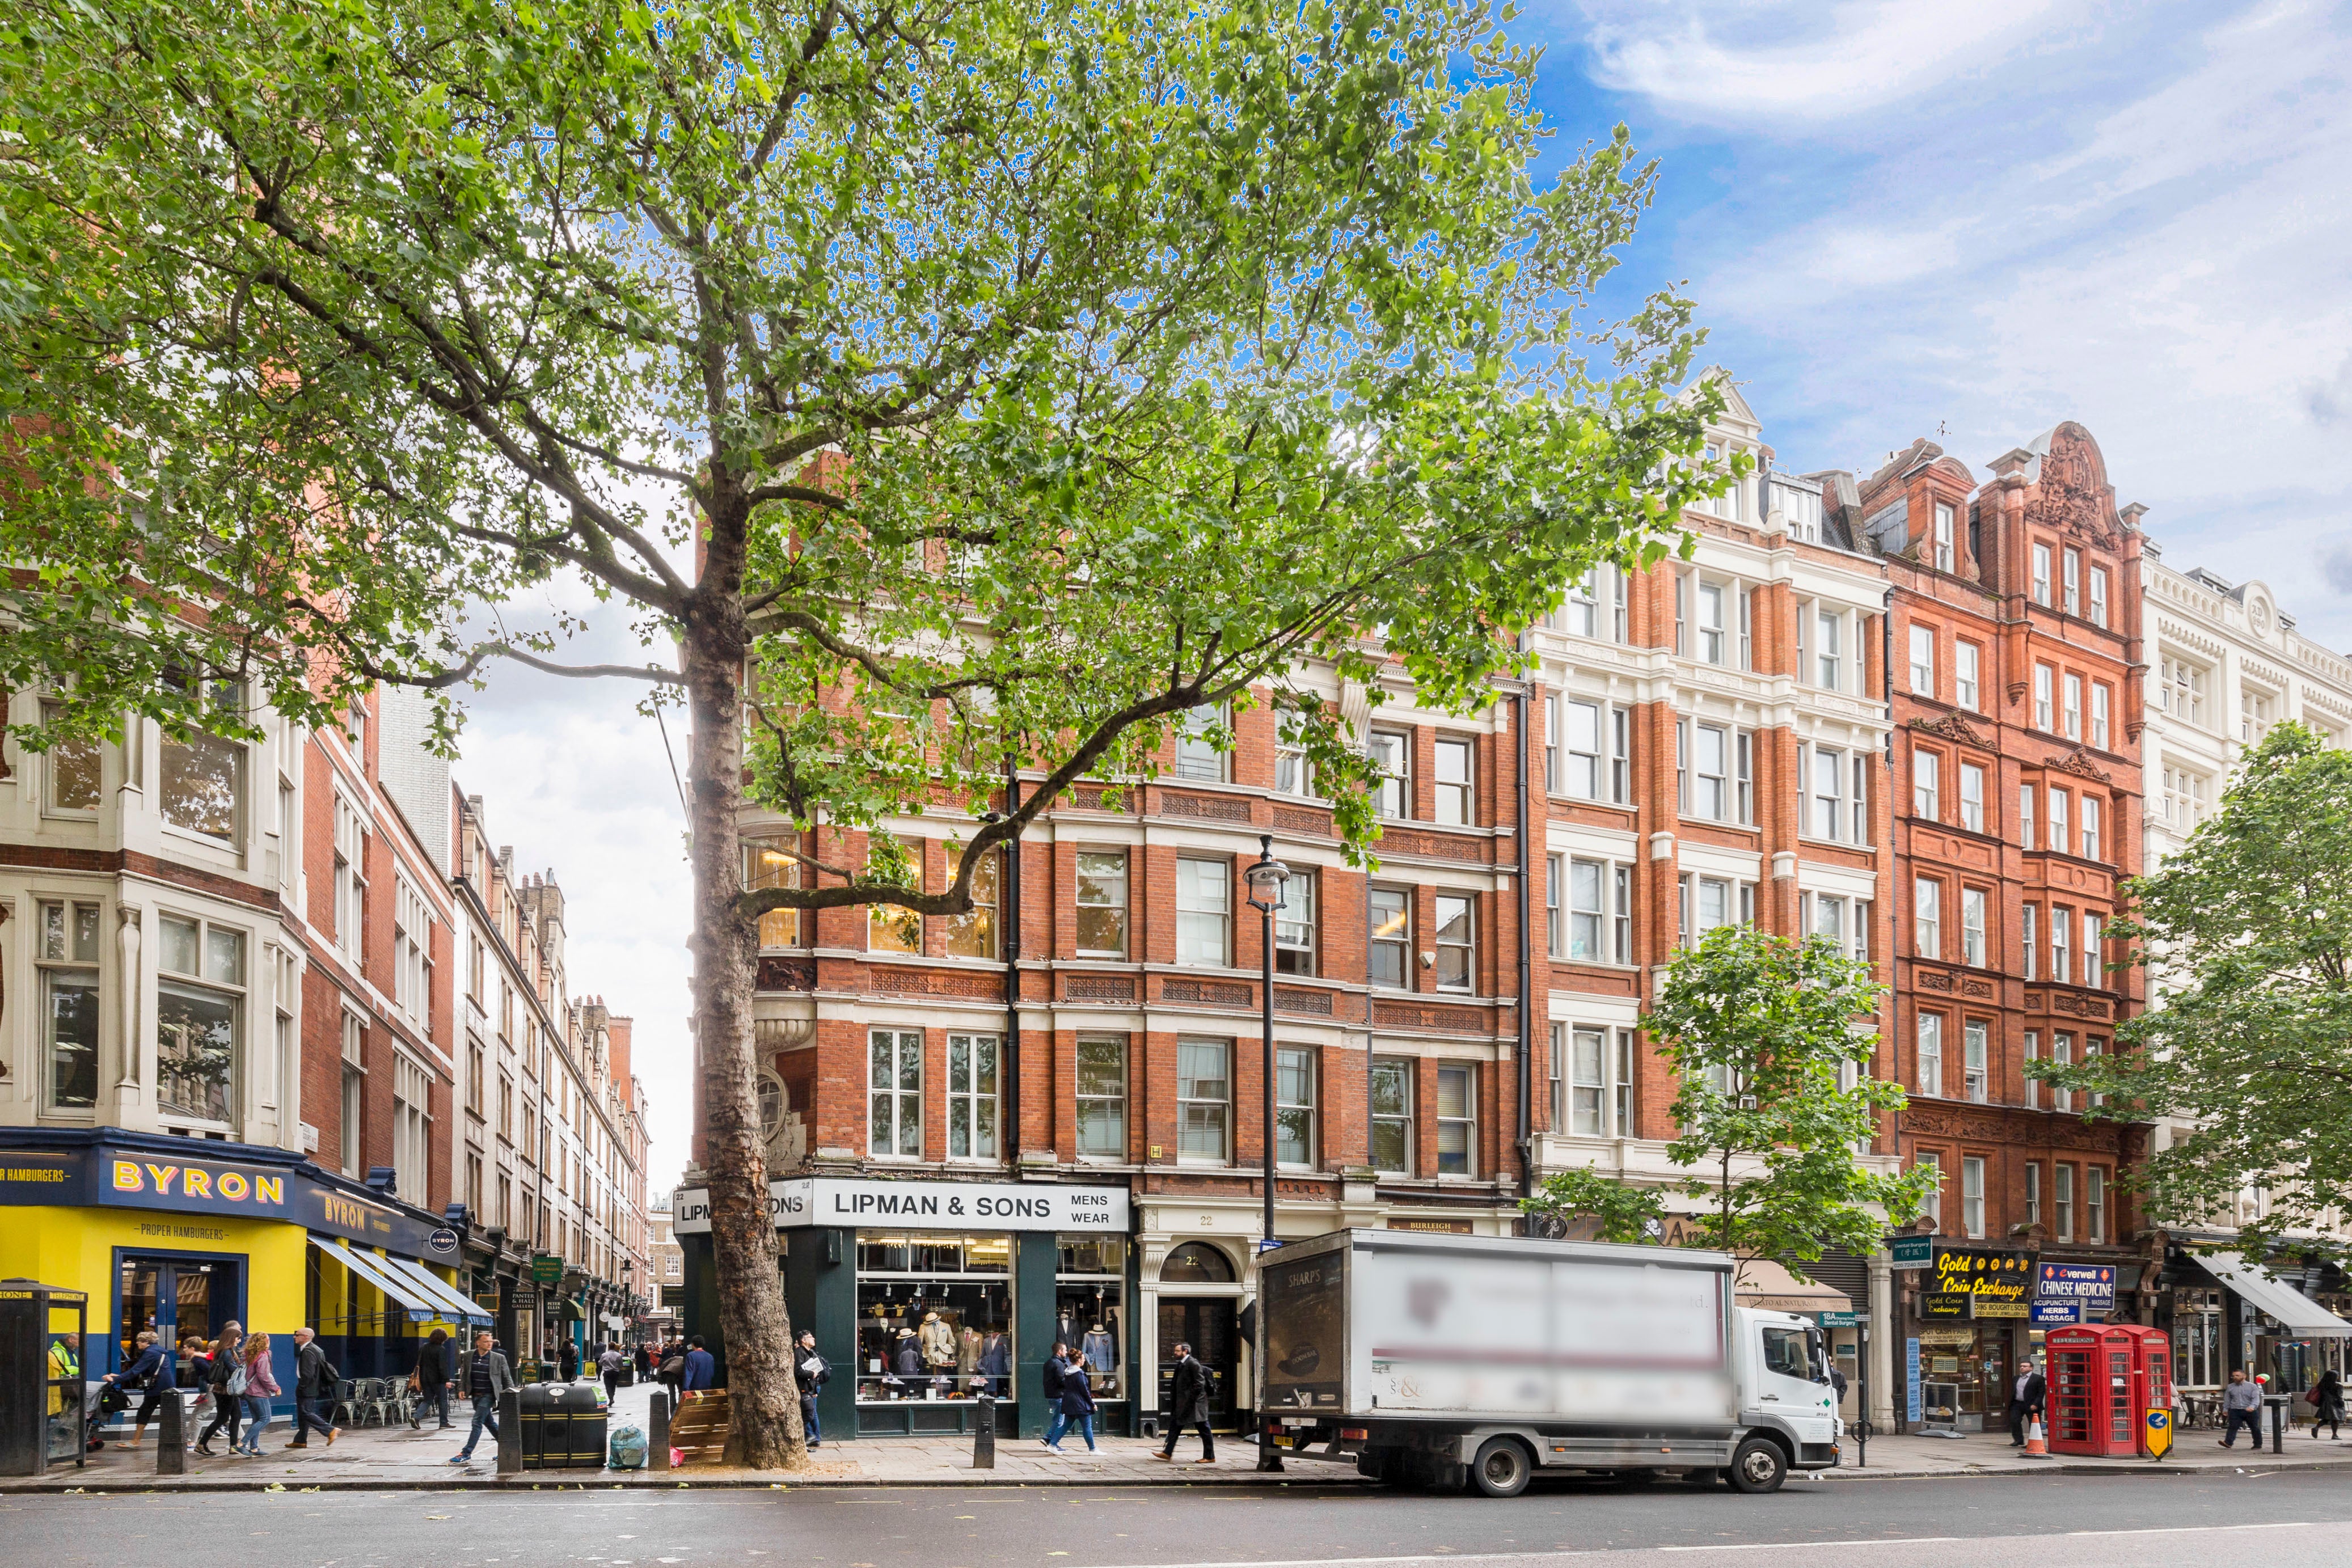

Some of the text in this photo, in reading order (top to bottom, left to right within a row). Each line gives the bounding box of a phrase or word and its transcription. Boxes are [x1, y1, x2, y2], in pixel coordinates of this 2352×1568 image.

[7, 1168, 64, 1182] HAMBURGERS
[113, 1160, 284, 1205] BYRON
[835, 1193, 1051, 1218] LIPMAN & SONS
[1071, 1195, 1108, 1206] MENS
[325, 1197, 365, 1232] BYRON
[1071, 1212, 1109, 1224] WEAR
[1200, 1216, 1213, 1225] 22
[141, 1223, 223, 1241] PROPER HAMBURGERS
[1186, 1256, 1198, 1265] 22
[1937, 1253, 1971, 1279] Gold
[1288, 1269, 1320, 1287] SHARP'S
[2059, 1269, 2096, 1279] everwell
[1943, 1277, 2025, 1301] Coin Exchange
[2040, 1280, 2113, 1297] CHINESE MEDICINE
[1925, 1297, 1943, 1307] Gold
[1928, 1305, 1961, 1315] Exchange
